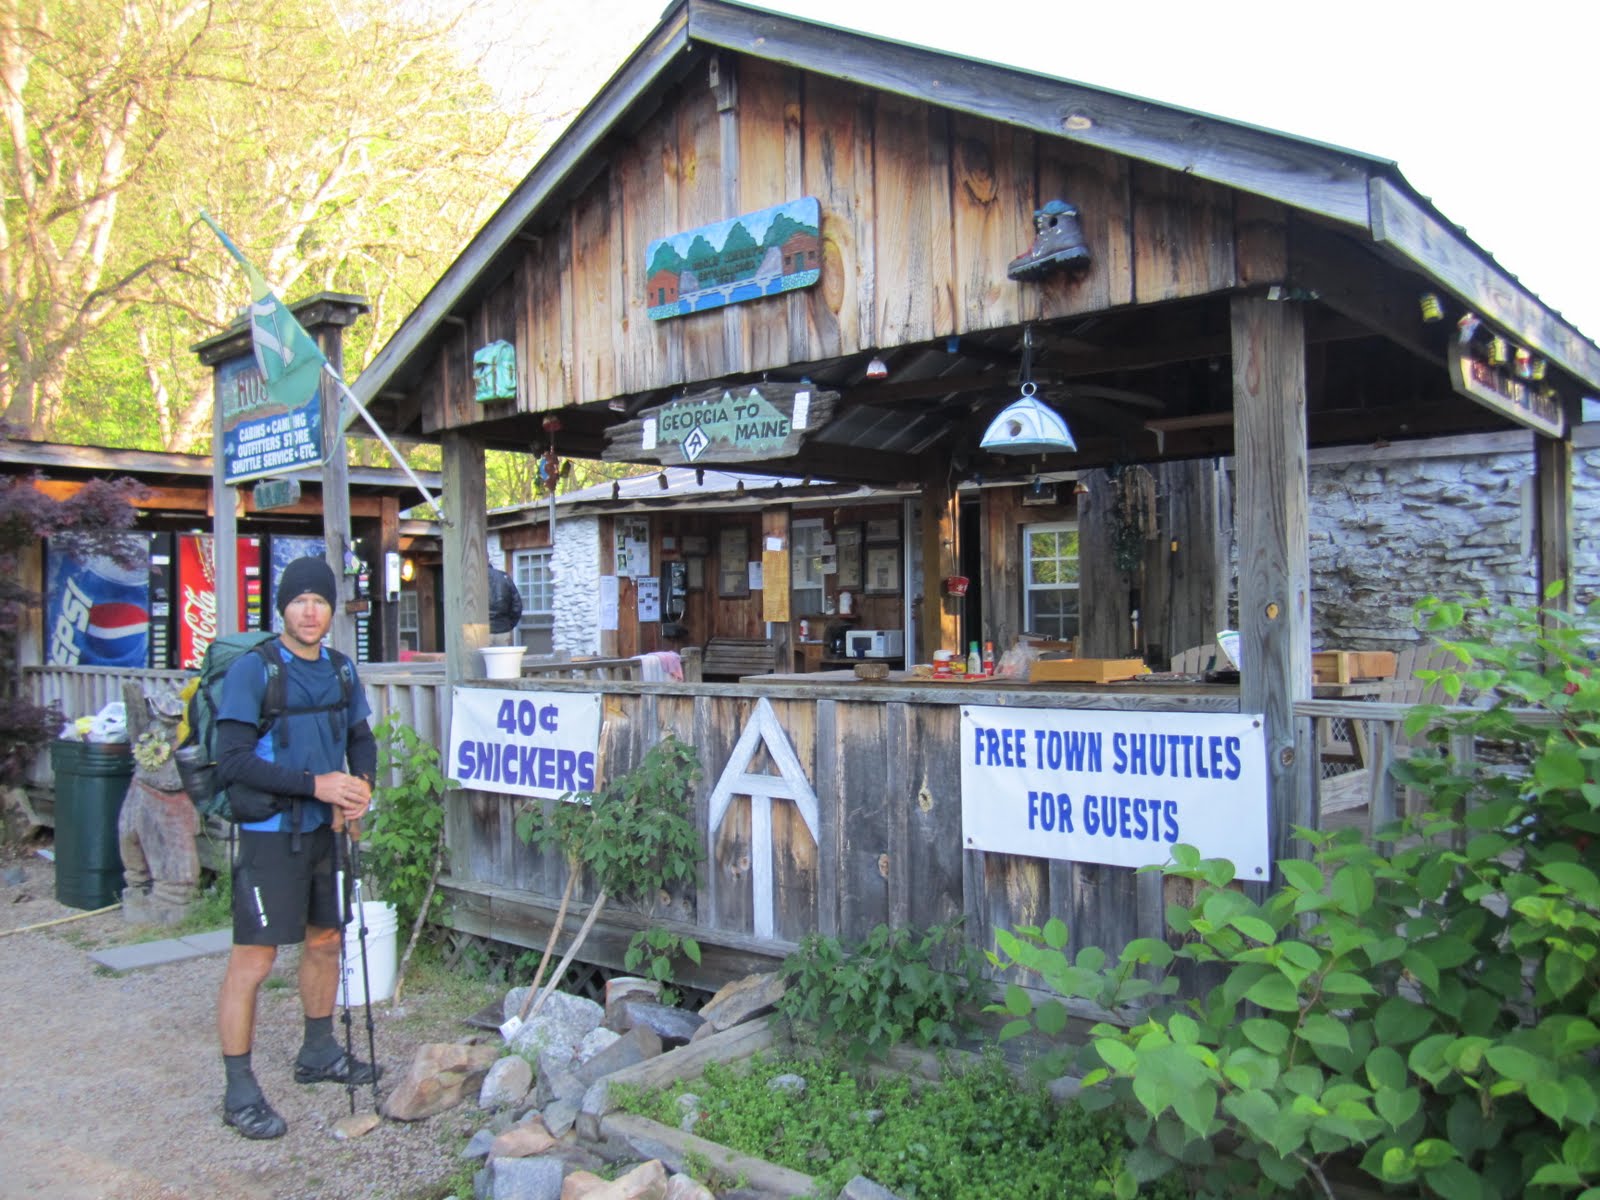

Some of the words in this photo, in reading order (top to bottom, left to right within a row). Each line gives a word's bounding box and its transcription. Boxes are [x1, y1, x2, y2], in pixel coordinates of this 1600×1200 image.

[239, 423, 266, 443] CABINS
[271, 412, 306, 435] CAMING
[662, 408, 728, 431] GEORGIA
[733, 403, 760, 419] TO
[735, 420, 789, 441] MAINE
[231, 455, 262, 475] SHUTTLE
[263, 447, 295, 468] SERVICE
[237, 435, 281, 458] OUTFITTERS
[47, 576, 94, 667] EPSI
[497, 698, 559, 737] 40¢
[457, 740, 595, 793] SNICKERS
[974, 727, 1027, 768] FREE
[1034, 730, 1102, 772] TOWN
[1112, 732, 1241, 780] SHUTTLES
[1027, 791, 1074, 833] FOR
[1083, 794, 1180, 843] GUESTS
